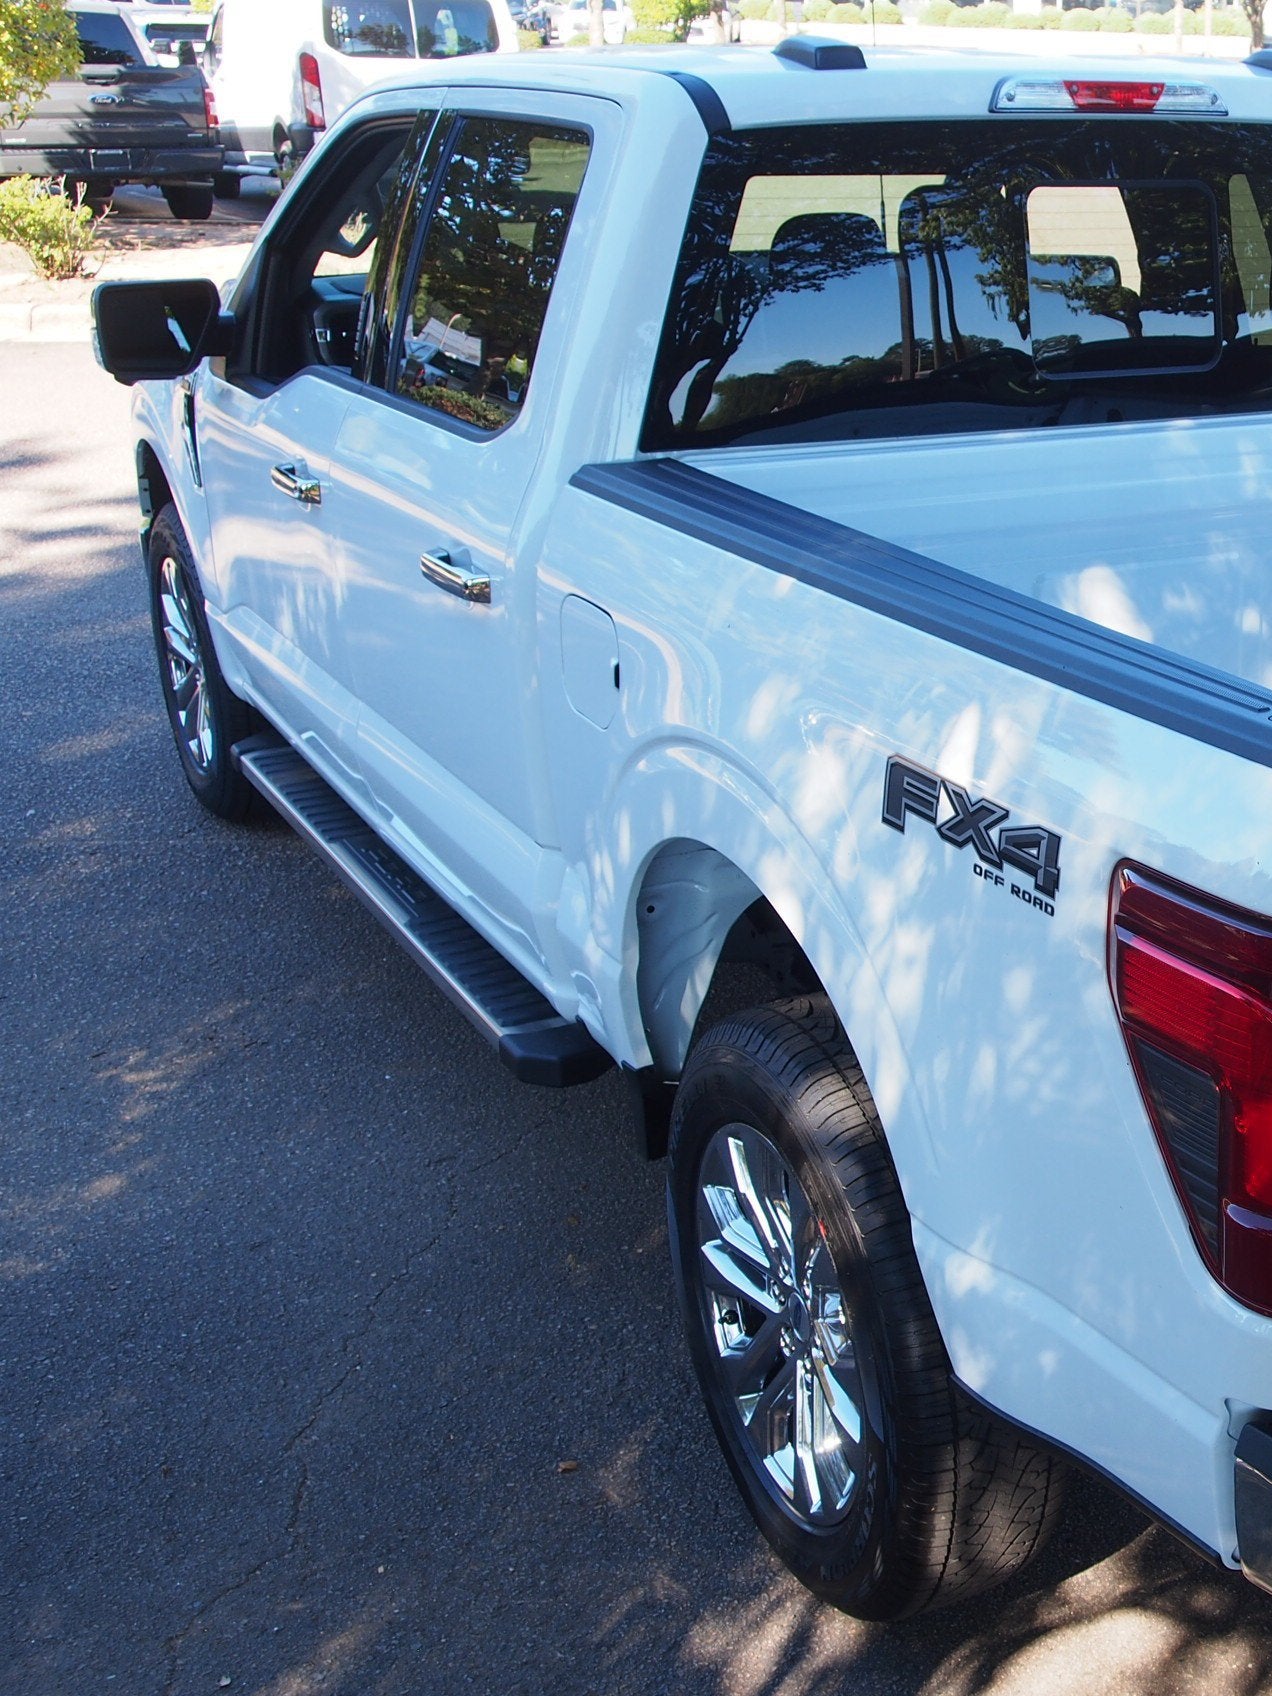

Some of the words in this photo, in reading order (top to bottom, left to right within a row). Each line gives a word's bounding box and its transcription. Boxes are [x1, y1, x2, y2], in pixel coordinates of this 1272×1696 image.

[881, 753, 1063, 901] FX4
[973, 862, 1005, 887] OFF
[1010, 882, 1056, 918] ROAD
